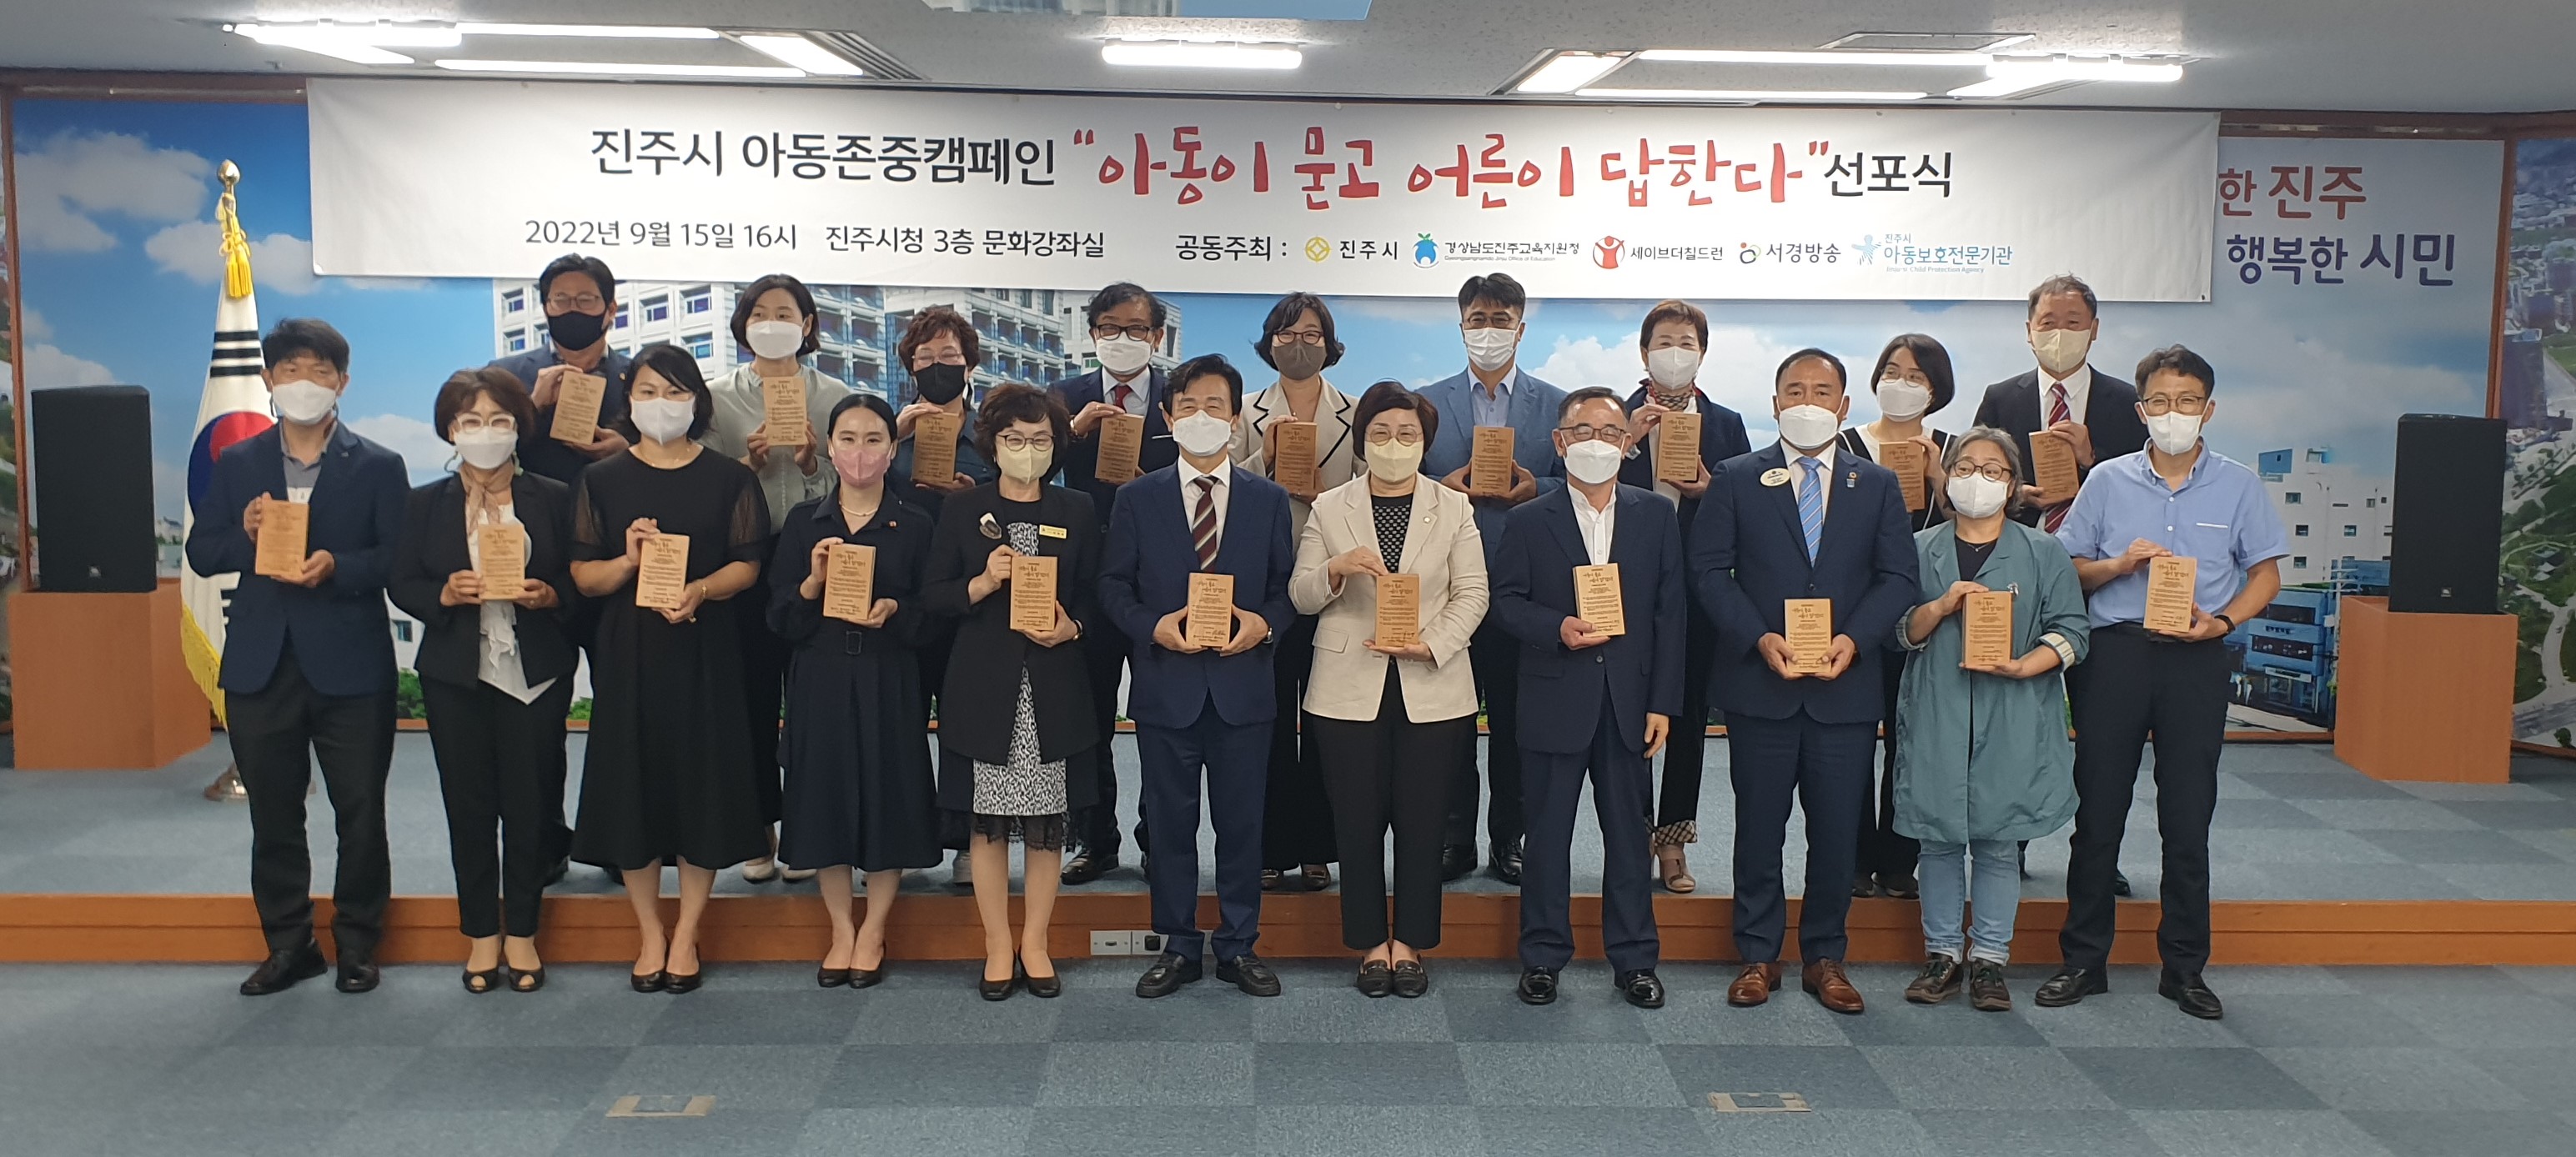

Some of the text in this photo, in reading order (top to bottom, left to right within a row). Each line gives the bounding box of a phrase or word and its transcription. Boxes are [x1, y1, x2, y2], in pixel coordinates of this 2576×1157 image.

[591, 128, 723, 177] 진주시
[742, 132, 1055, 186] 아동존중캠페인
[1294, 127, 1379, 210] 묻고
[1408, 133, 1574, 209] 어른이
[2268, 166, 2367, 220] 진주
[525, 220, 1105, 258] 2022년 9월 15일 16시 진주시청 3층 문화강좌실
[1176, 234, 1272, 262] 공동주최
[1444, 241, 1580, 255] 경상남도진주교육지원청
[1885, 233, 1912, 244] 진주시
[1630, 246, 1723, 261] 세이브더칠드런
[1766, 243, 1841, 264] 서경방송
[1884, 245, 2013, 266] 아동보호전문기관
[2226, 233, 2455, 287] 행복한 시민
